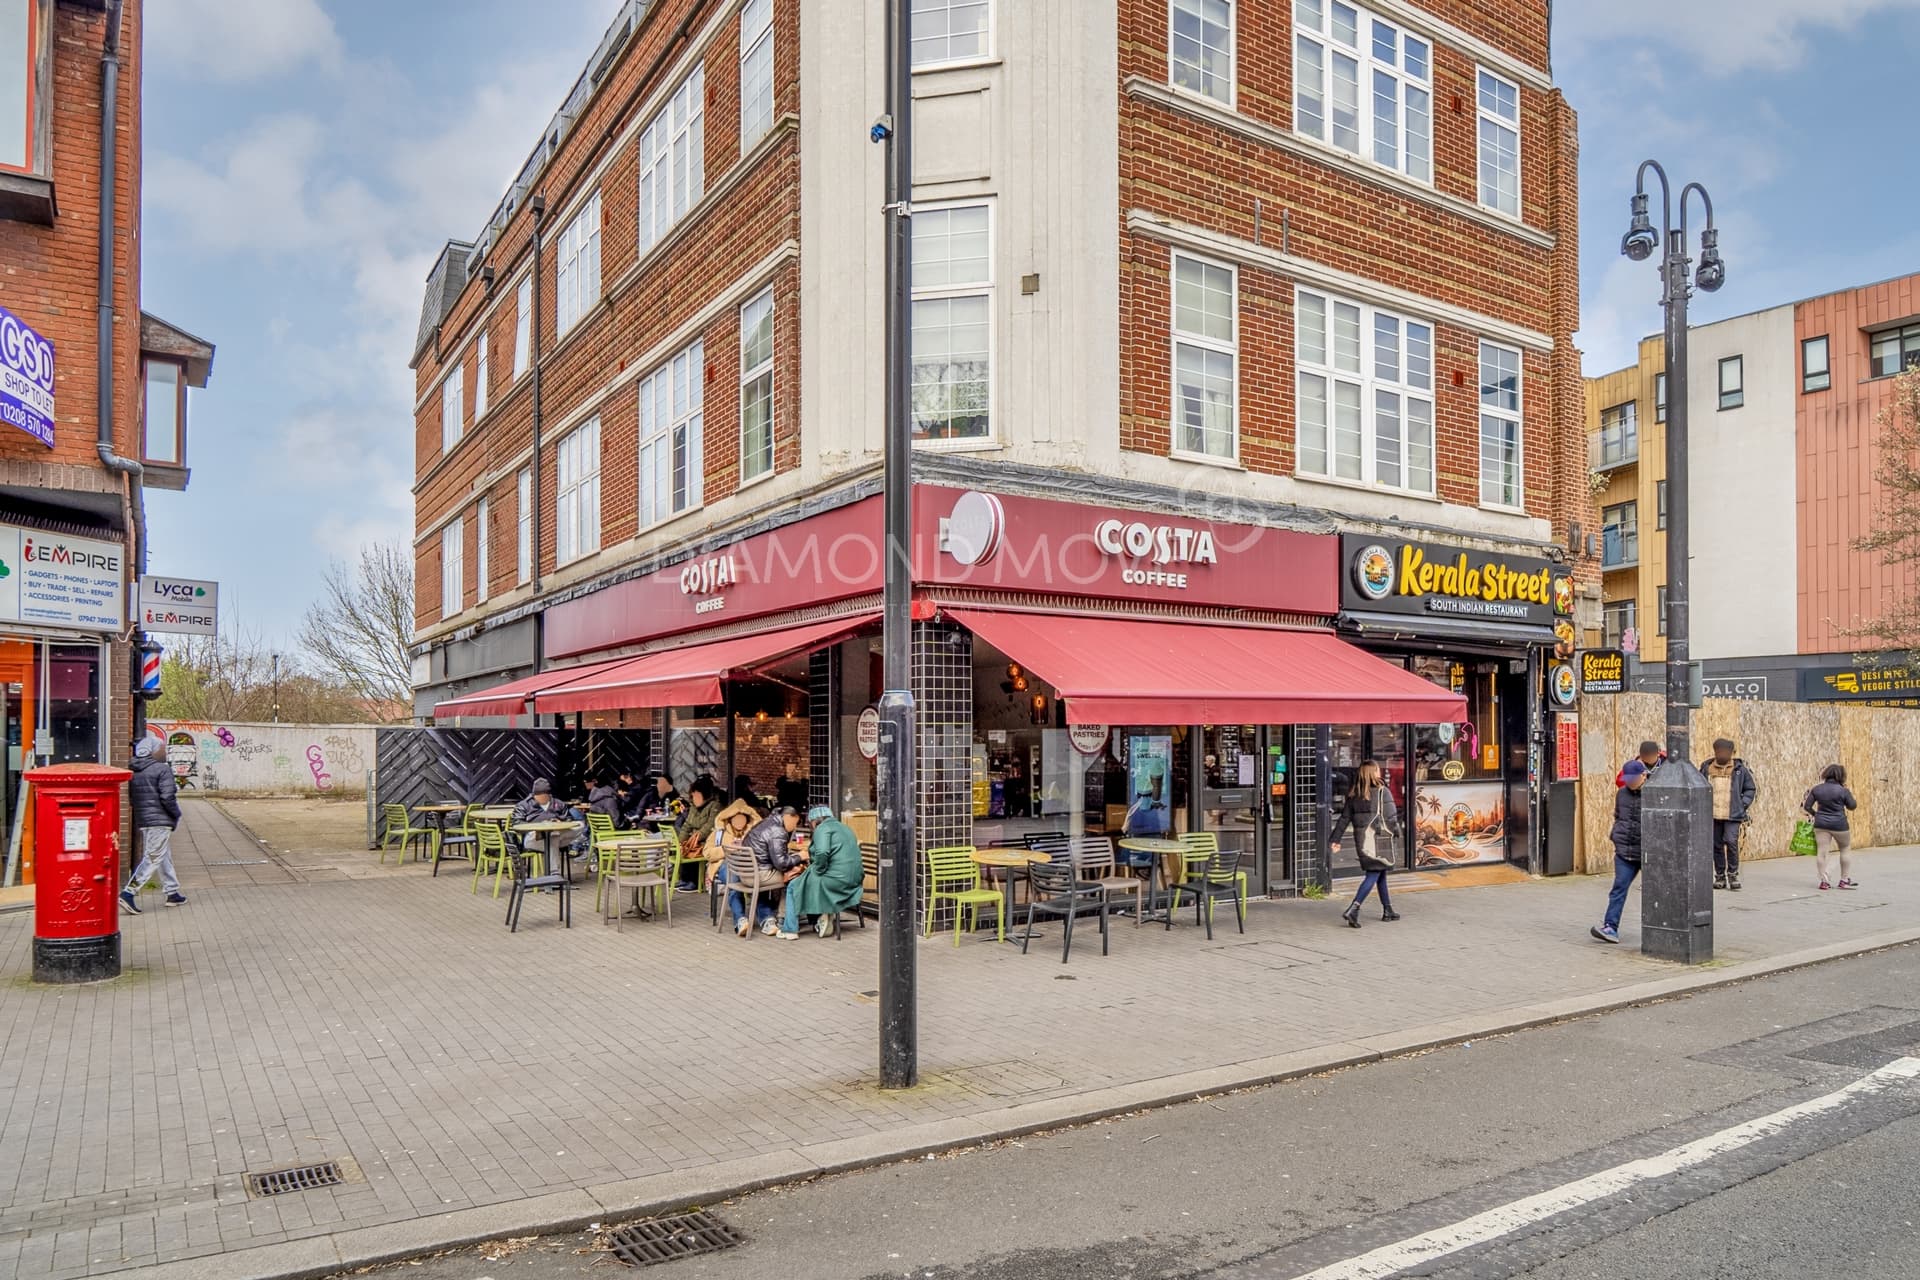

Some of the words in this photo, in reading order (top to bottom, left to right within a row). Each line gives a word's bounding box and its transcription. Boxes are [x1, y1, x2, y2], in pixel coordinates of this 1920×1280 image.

[0, 316, 54, 392] GSD
[5, 371, 29, 396] SHOP
[31, 386, 41, 406] TO
[42, 394, 53, 413] LET
[3, 402, 26, 427] 0208
[27, 415, 41, 435] 570
[1095, 518, 1218, 565] COSTA
[28, 570, 58, 580] GADGETS
[63, 575, 89, 584] PHONES
[93, 579, 119, 588] LAPTOPS
[1122, 568, 1188, 589] COFFEE
[1400, 544, 1480, 597] Kerala
[1481, 562, 1551, 605] Street
[28, 581, 42, 589] BUY
[47, 583, 67, 592] TRADE
[72, 586, 86, 594] SELL
[90, 589, 114, 598] REPAIRS
[154, 580, 193, 597] Lyca
[28, 592, 70, 603] ACCESSORIES
[74, 597, 103, 606] PRINTING
[695, 597, 725, 615] COFFEE
[1431, 598, 1457, 612] SOUTH
[1458, 600, 1484, 615] INDIAN
[1485, 603, 1529, 618] RESTAURANT
[1583, 654, 1622, 670] Kerala
[1585, 667, 1621, 681] Street
[1861, 671, 1881, 680] DESI
[1702, 683, 1760, 695] DALCO
[1862, 681, 1892, 691] VEGGIE
[1894, 679, 1920, 689] STYLE
[1446, 768, 1461, 776] OPEN
